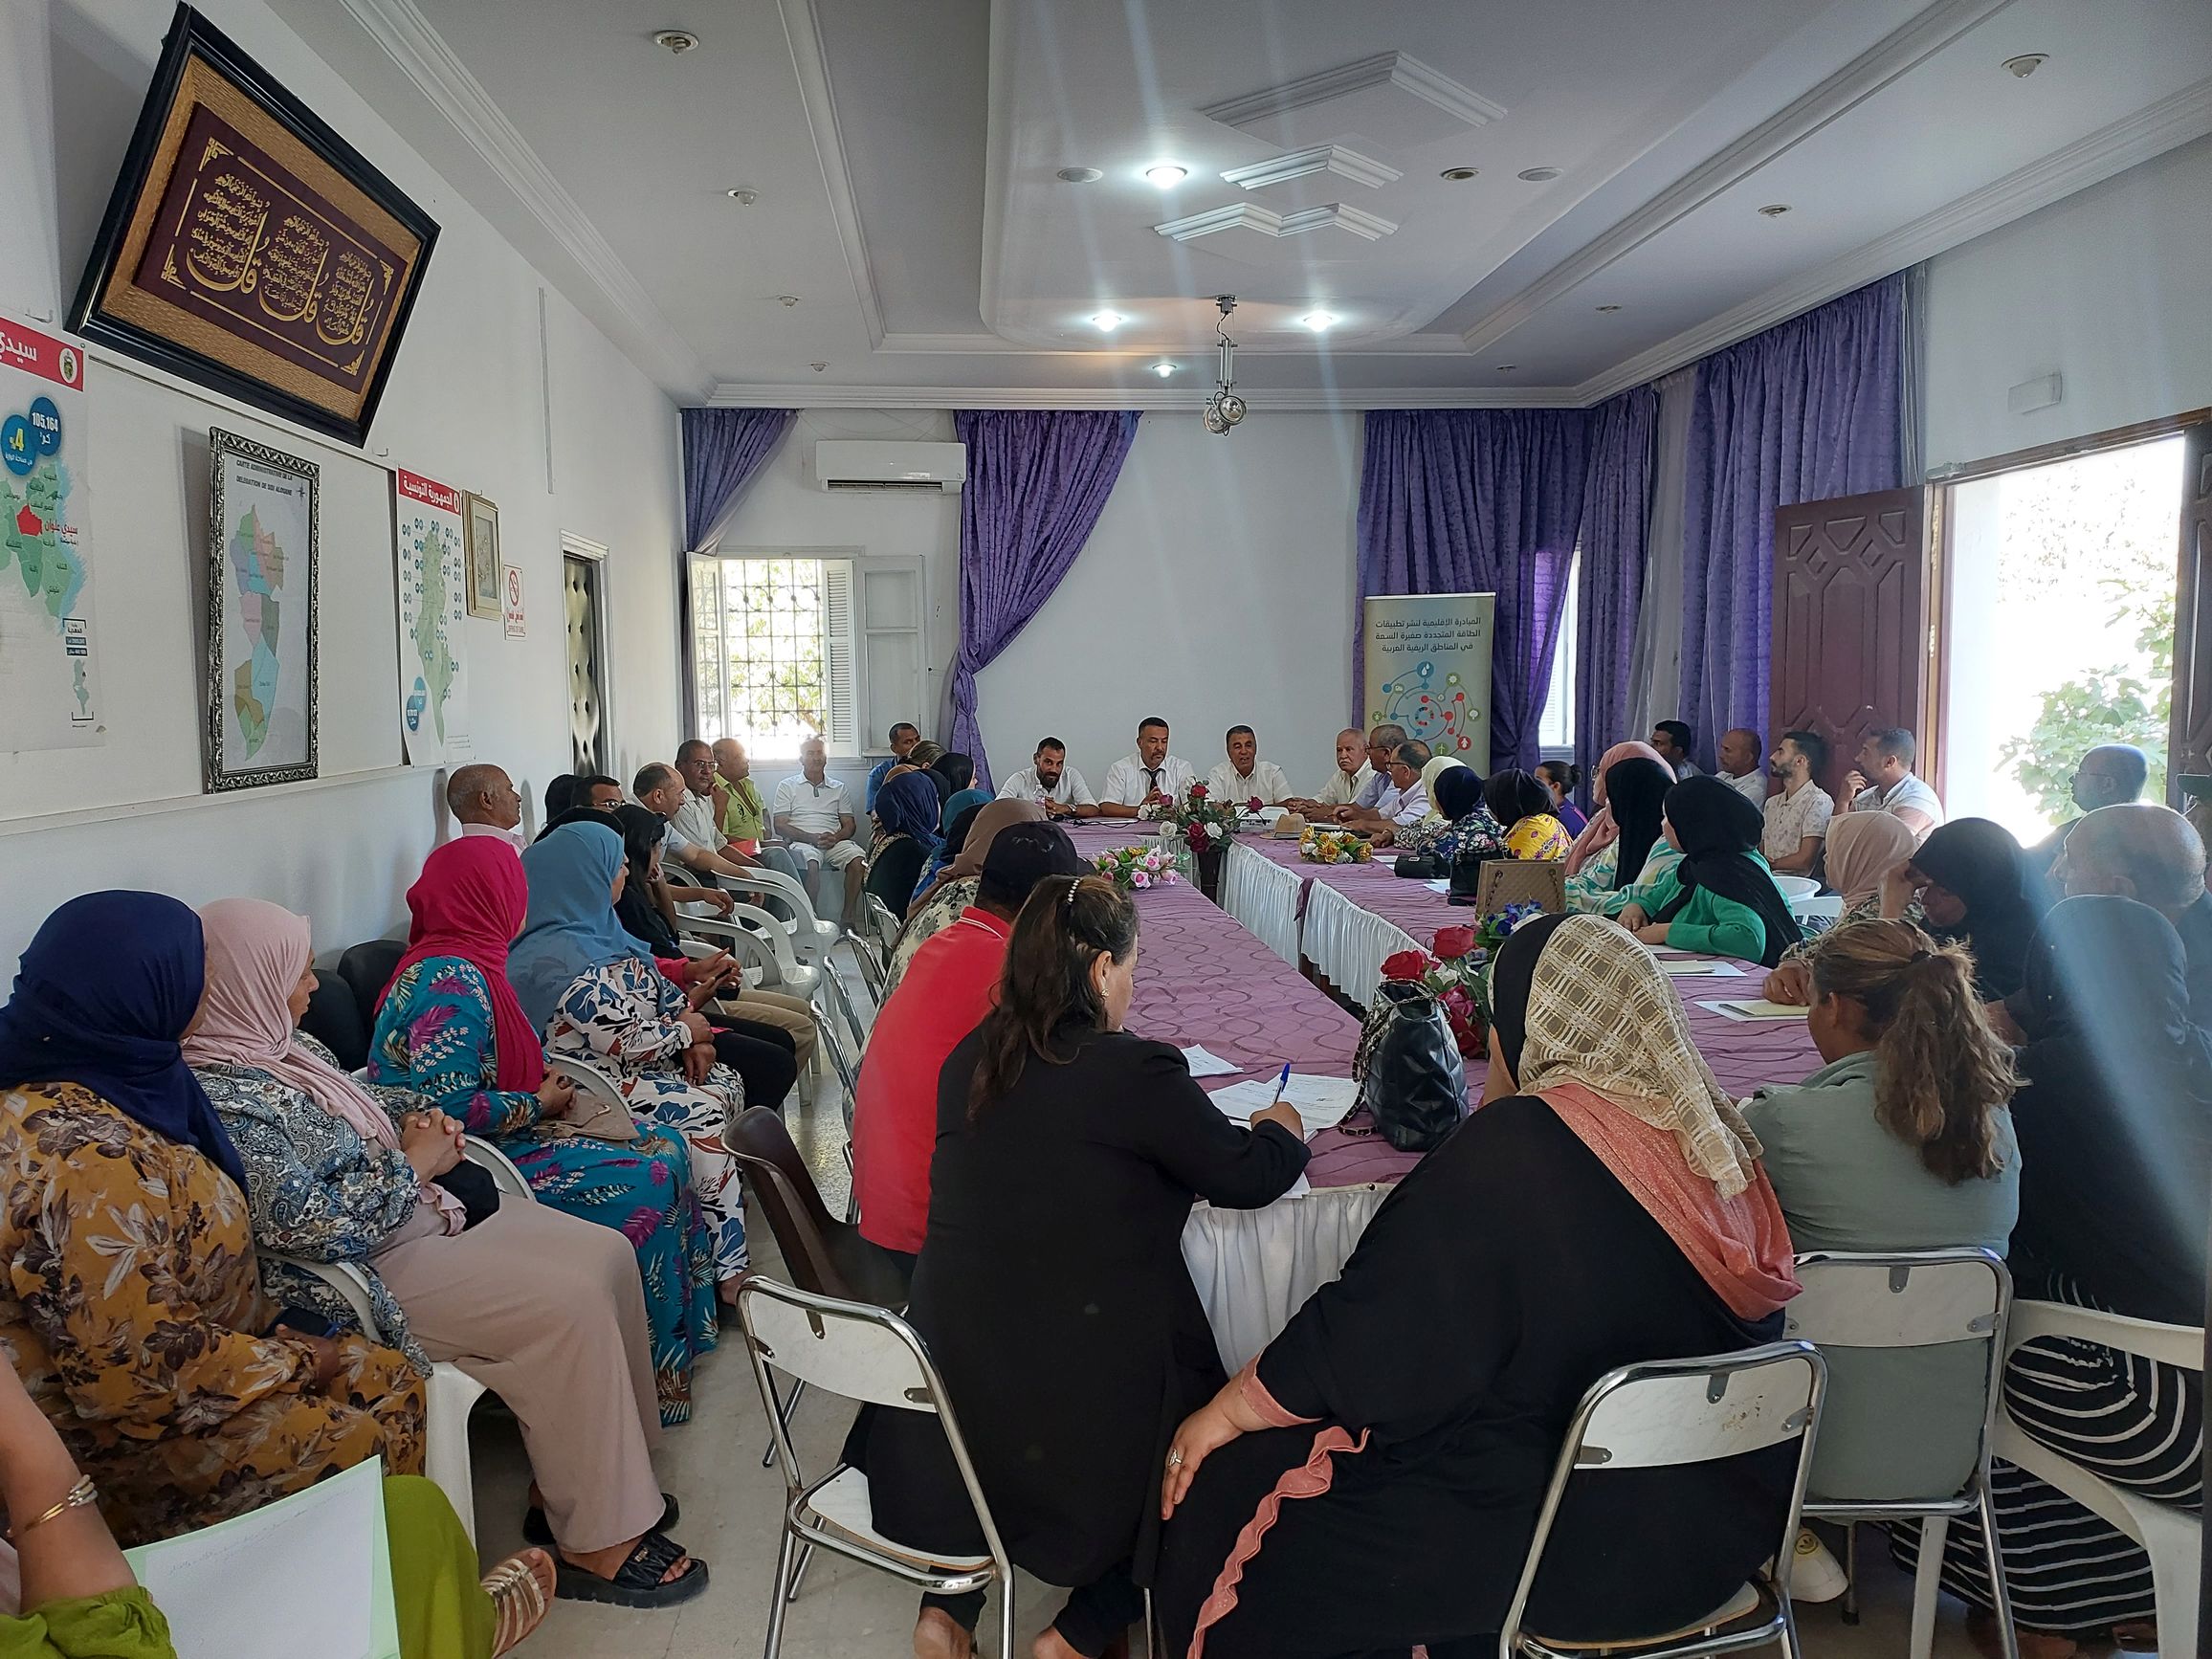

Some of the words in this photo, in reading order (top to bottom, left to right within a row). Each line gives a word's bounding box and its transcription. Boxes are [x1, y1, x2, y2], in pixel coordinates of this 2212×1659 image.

[32, 412, 58, 431] 105,164
[403, 476, 428, 498] التونسية
[428, 485, 453, 508] الجمهورية
[1375, 620, 1405, 629] تطبيقات
[1406, 619, 1421, 629] لنشر
[1455, 617, 1481, 627] المبادرة
[1400, 632, 1422, 641] صغيرة
[1424, 630, 1454, 639] المتجددة
[1382, 644, 1405, 653] العربية
[1406, 644, 1428, 653] الريفية
[1430, 643, 1459, 653] المناطق
